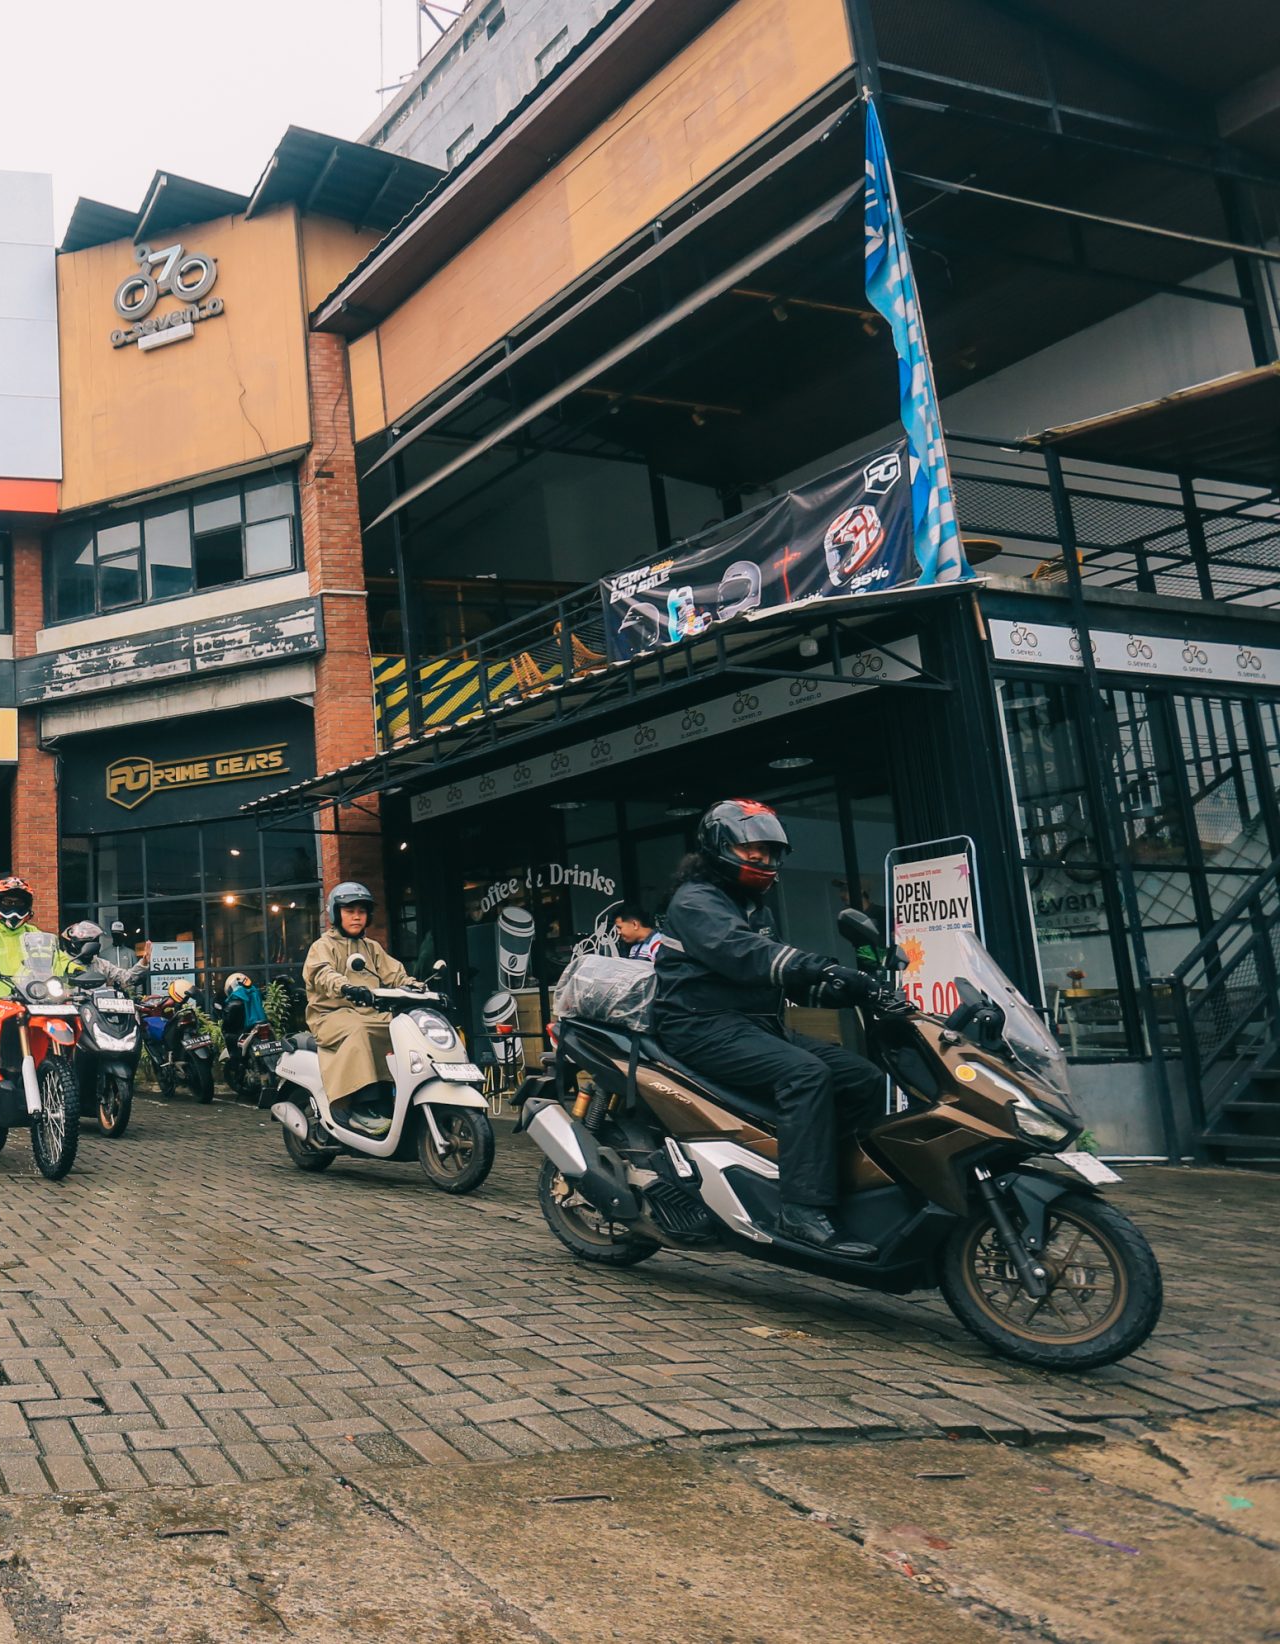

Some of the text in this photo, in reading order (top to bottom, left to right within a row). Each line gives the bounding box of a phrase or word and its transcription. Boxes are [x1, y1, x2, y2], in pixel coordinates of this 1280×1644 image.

[609, 569, 671, 604] END SALE
[610, 566, 651, 592] YEAR
[850, 566, 889, 590] 35%
[153, 750, 284, 786] PRIME GEARS
[549, 863, 616, 896] Drinks
[896, 880, 931, 904] OPEN
[896, 896, 969, 924] EVERYDAY
